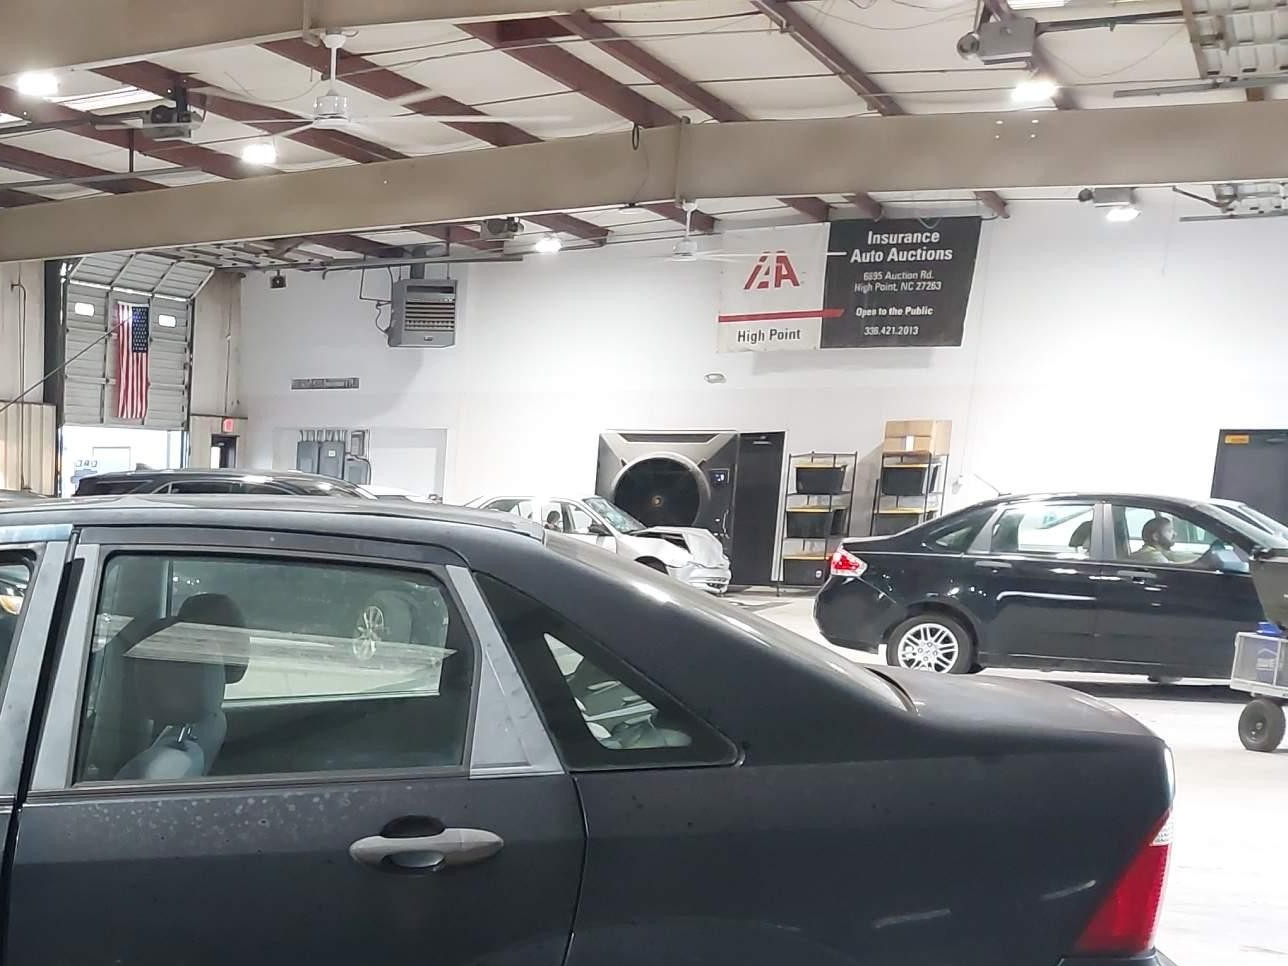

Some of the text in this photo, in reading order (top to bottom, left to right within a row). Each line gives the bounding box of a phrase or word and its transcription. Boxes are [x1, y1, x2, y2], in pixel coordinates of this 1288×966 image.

[867, 230, 940, 245] Insurance
[850, 246, 953, 264] Auto Auctions
[884, 271, 918, 280] Auction
[920, 269, 934, 279] Rd.
[854, 281, 942, 294] High Point, NC 27263
[855, 306, 934, 318] Open to the Public
[737, 328, 801, 344] High Point
